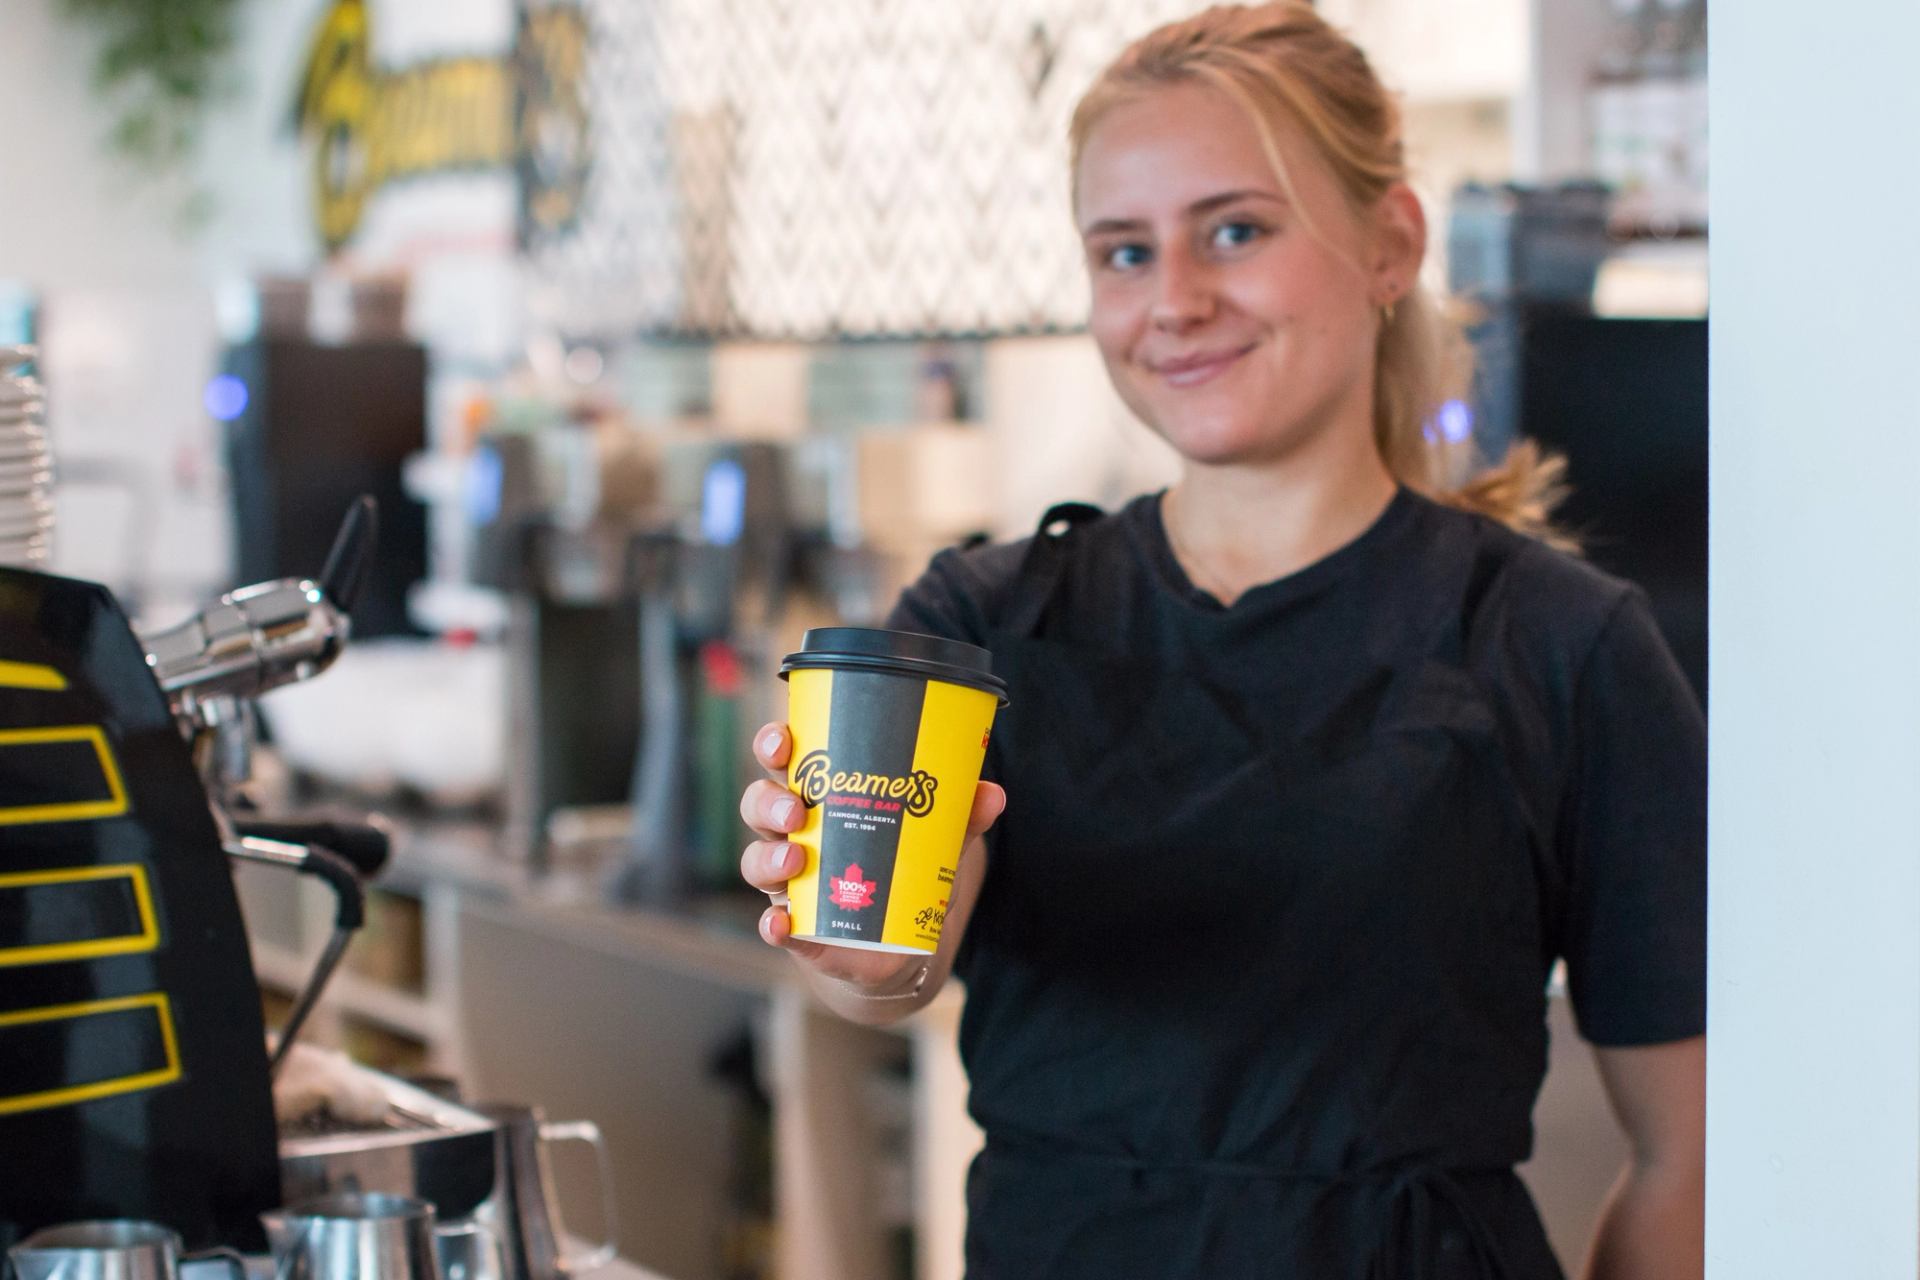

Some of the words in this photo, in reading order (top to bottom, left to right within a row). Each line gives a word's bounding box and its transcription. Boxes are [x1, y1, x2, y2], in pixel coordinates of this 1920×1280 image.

[795, 750, 938, 818] Beamer's
[826, 794, 872, 809] COFFEE
[874, 800, 902, 812] BAR
[828, 811, 862, 821] CANMORE,
[863, 815, 896, 825] ALBERTA
[843, 822, 859, 830] EST.
[838, 880, 867, 893] 100%
[831, 920, 862, 931] SMALL
